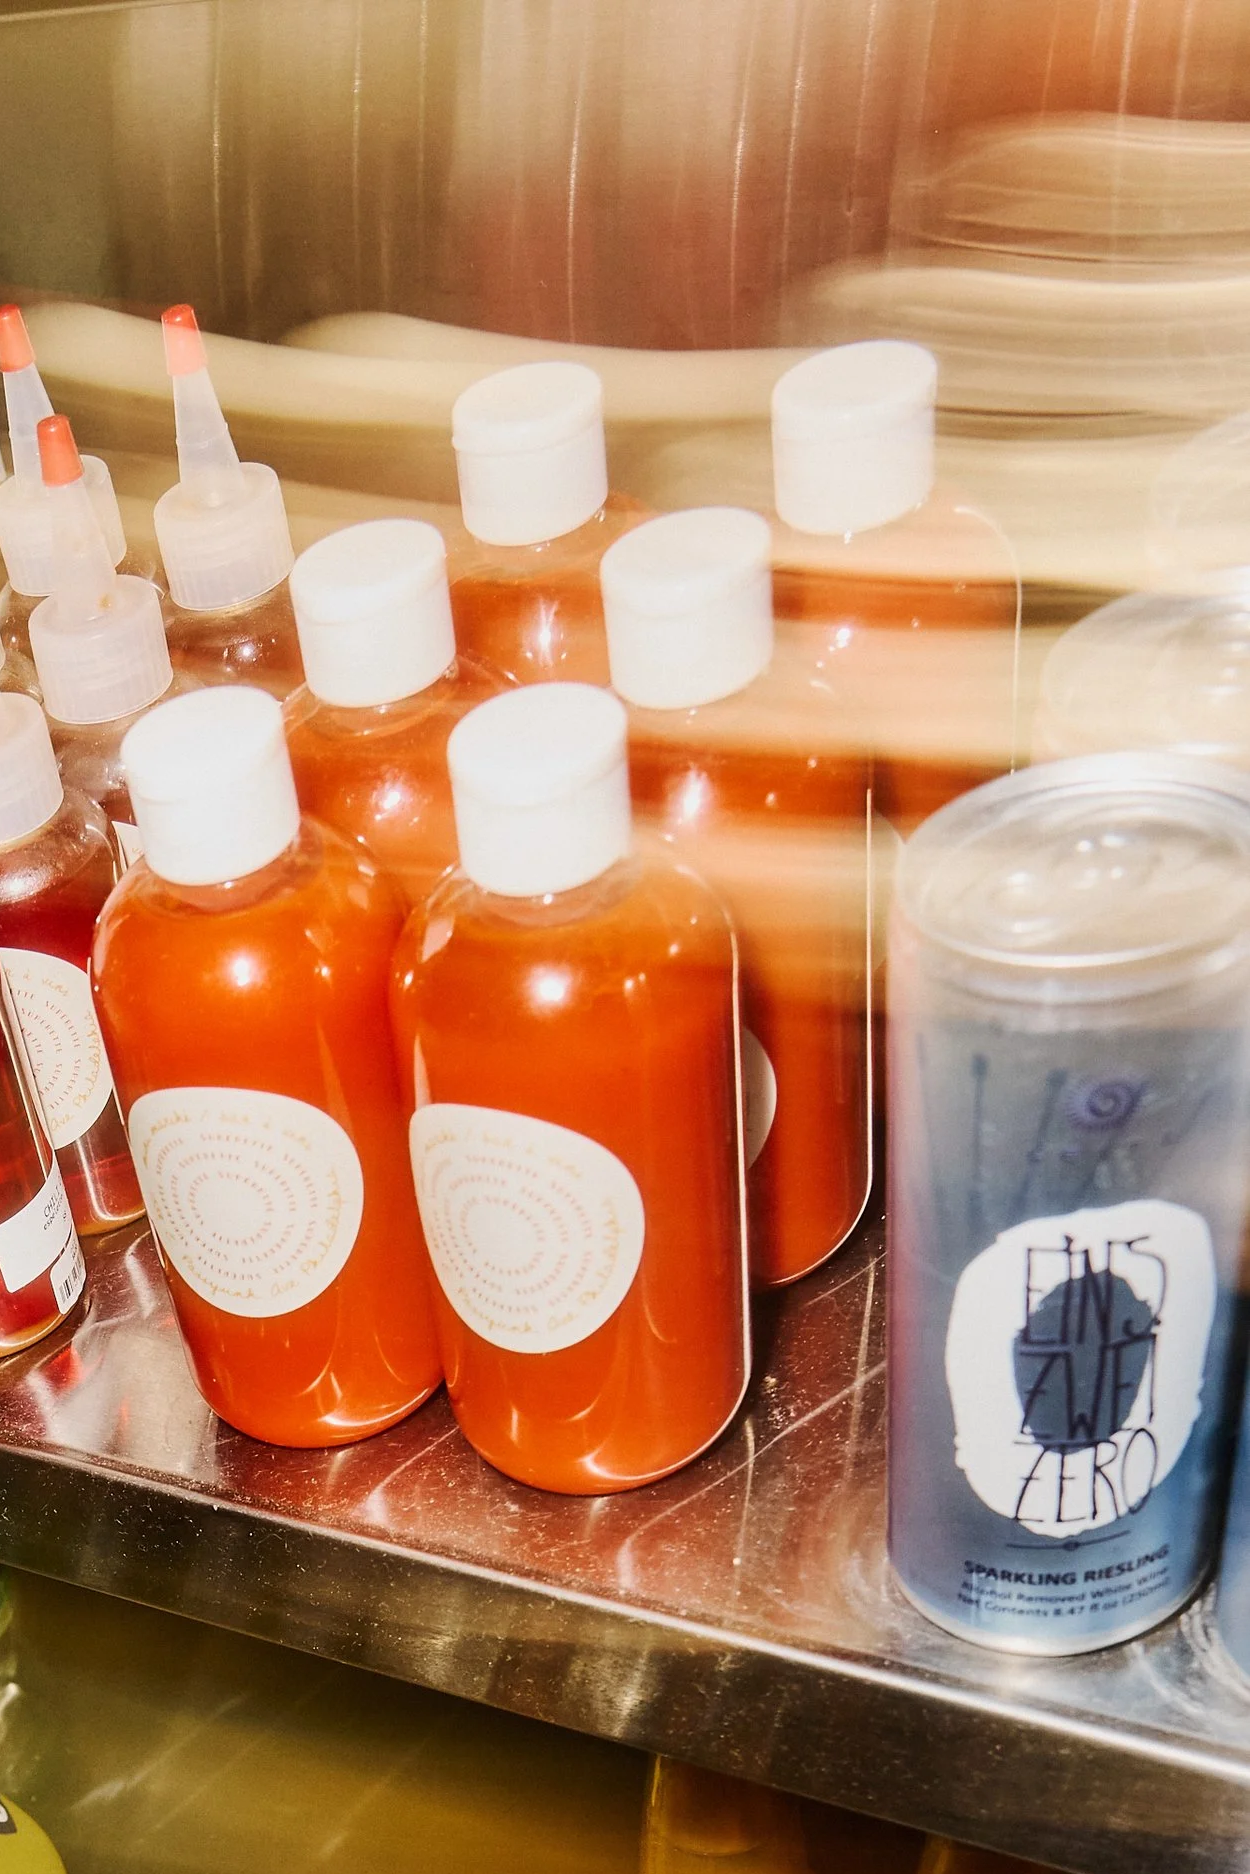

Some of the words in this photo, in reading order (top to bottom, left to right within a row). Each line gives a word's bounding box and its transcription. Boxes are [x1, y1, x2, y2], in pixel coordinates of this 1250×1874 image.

[1021, 1233, 1167, 1345] EINS
[1013, 1427, 1158, 1523] ZERO
[963, 1560, 1077, 1586] SPARKLING
[1083, 1543, 1170, 1582] RIESLING
[984, 1601, 1049, 1617] Contents
[1016, 1592, 1087, 1604] Removed
[1090, 1582, 1132, 1599] White
